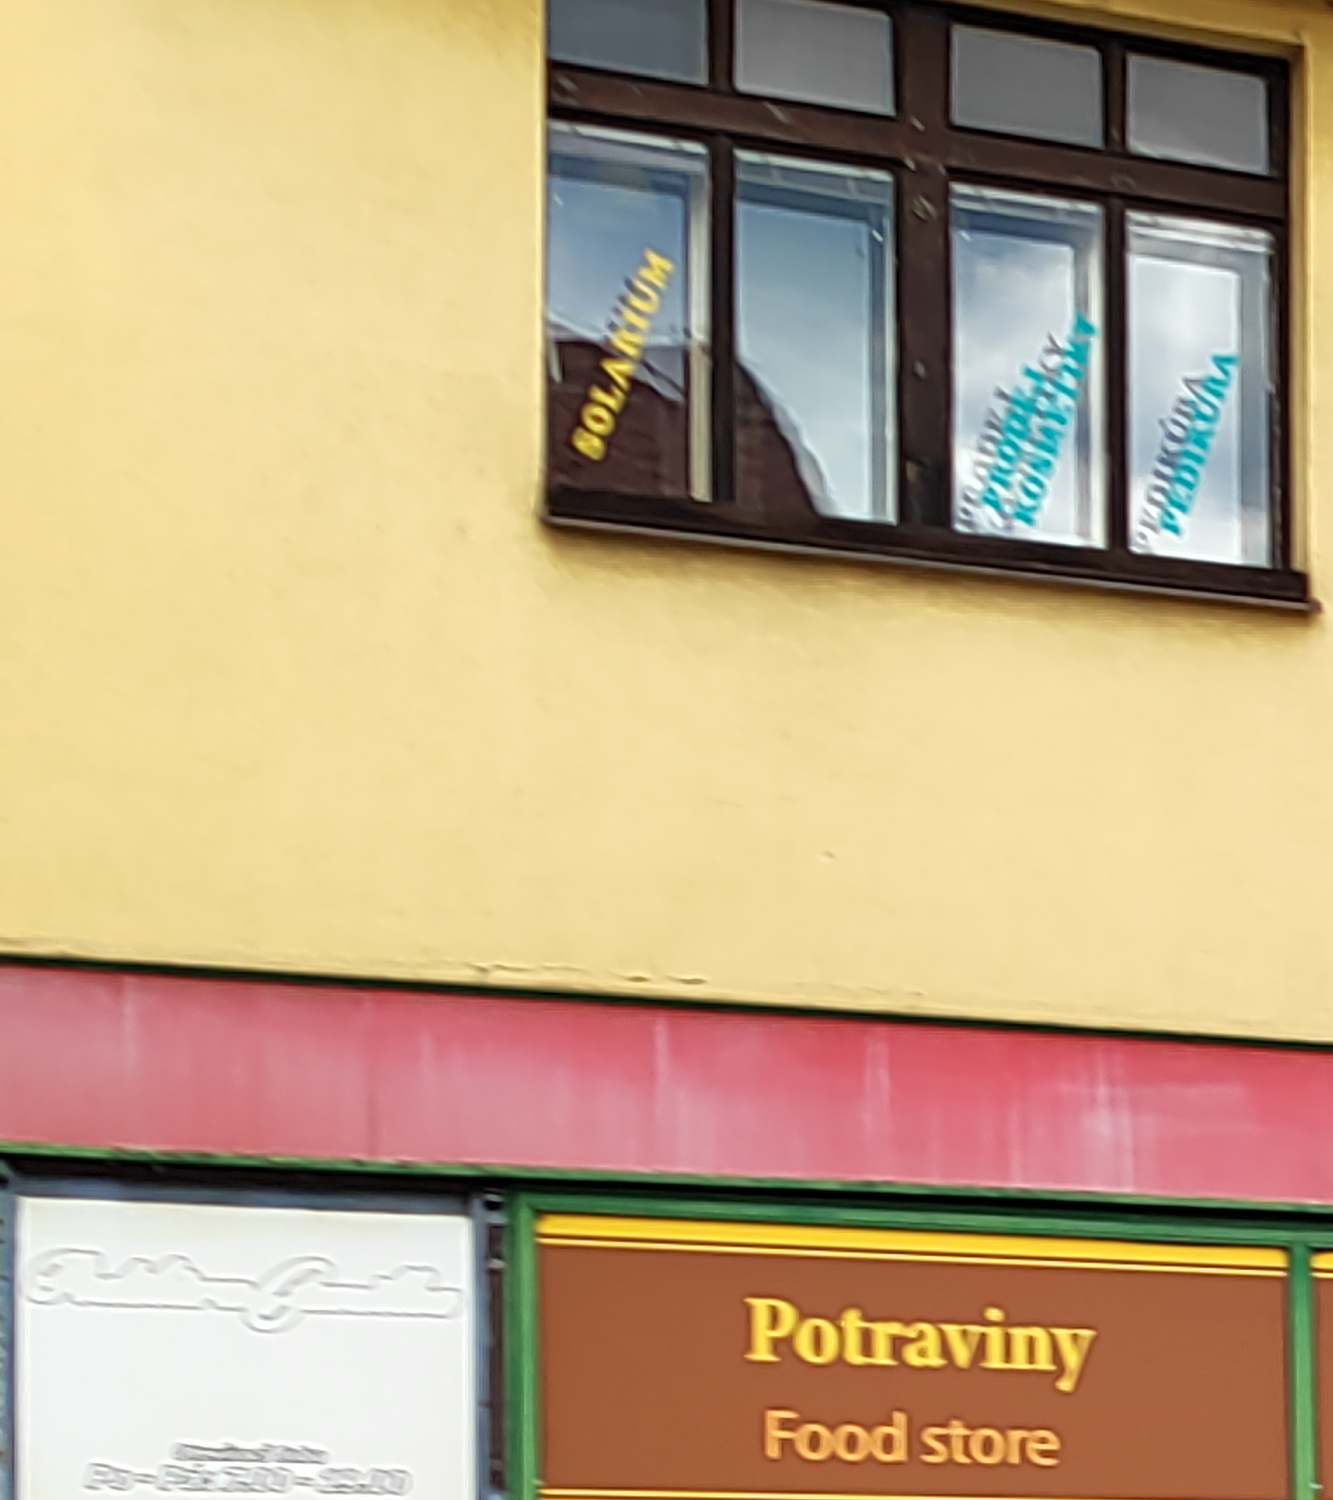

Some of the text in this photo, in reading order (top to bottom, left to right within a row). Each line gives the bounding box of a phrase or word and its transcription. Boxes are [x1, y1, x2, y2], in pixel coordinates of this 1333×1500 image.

[744, 1296, 1096, 1393] Potraviny
[765, 1410, 1061, 1466] Food store
